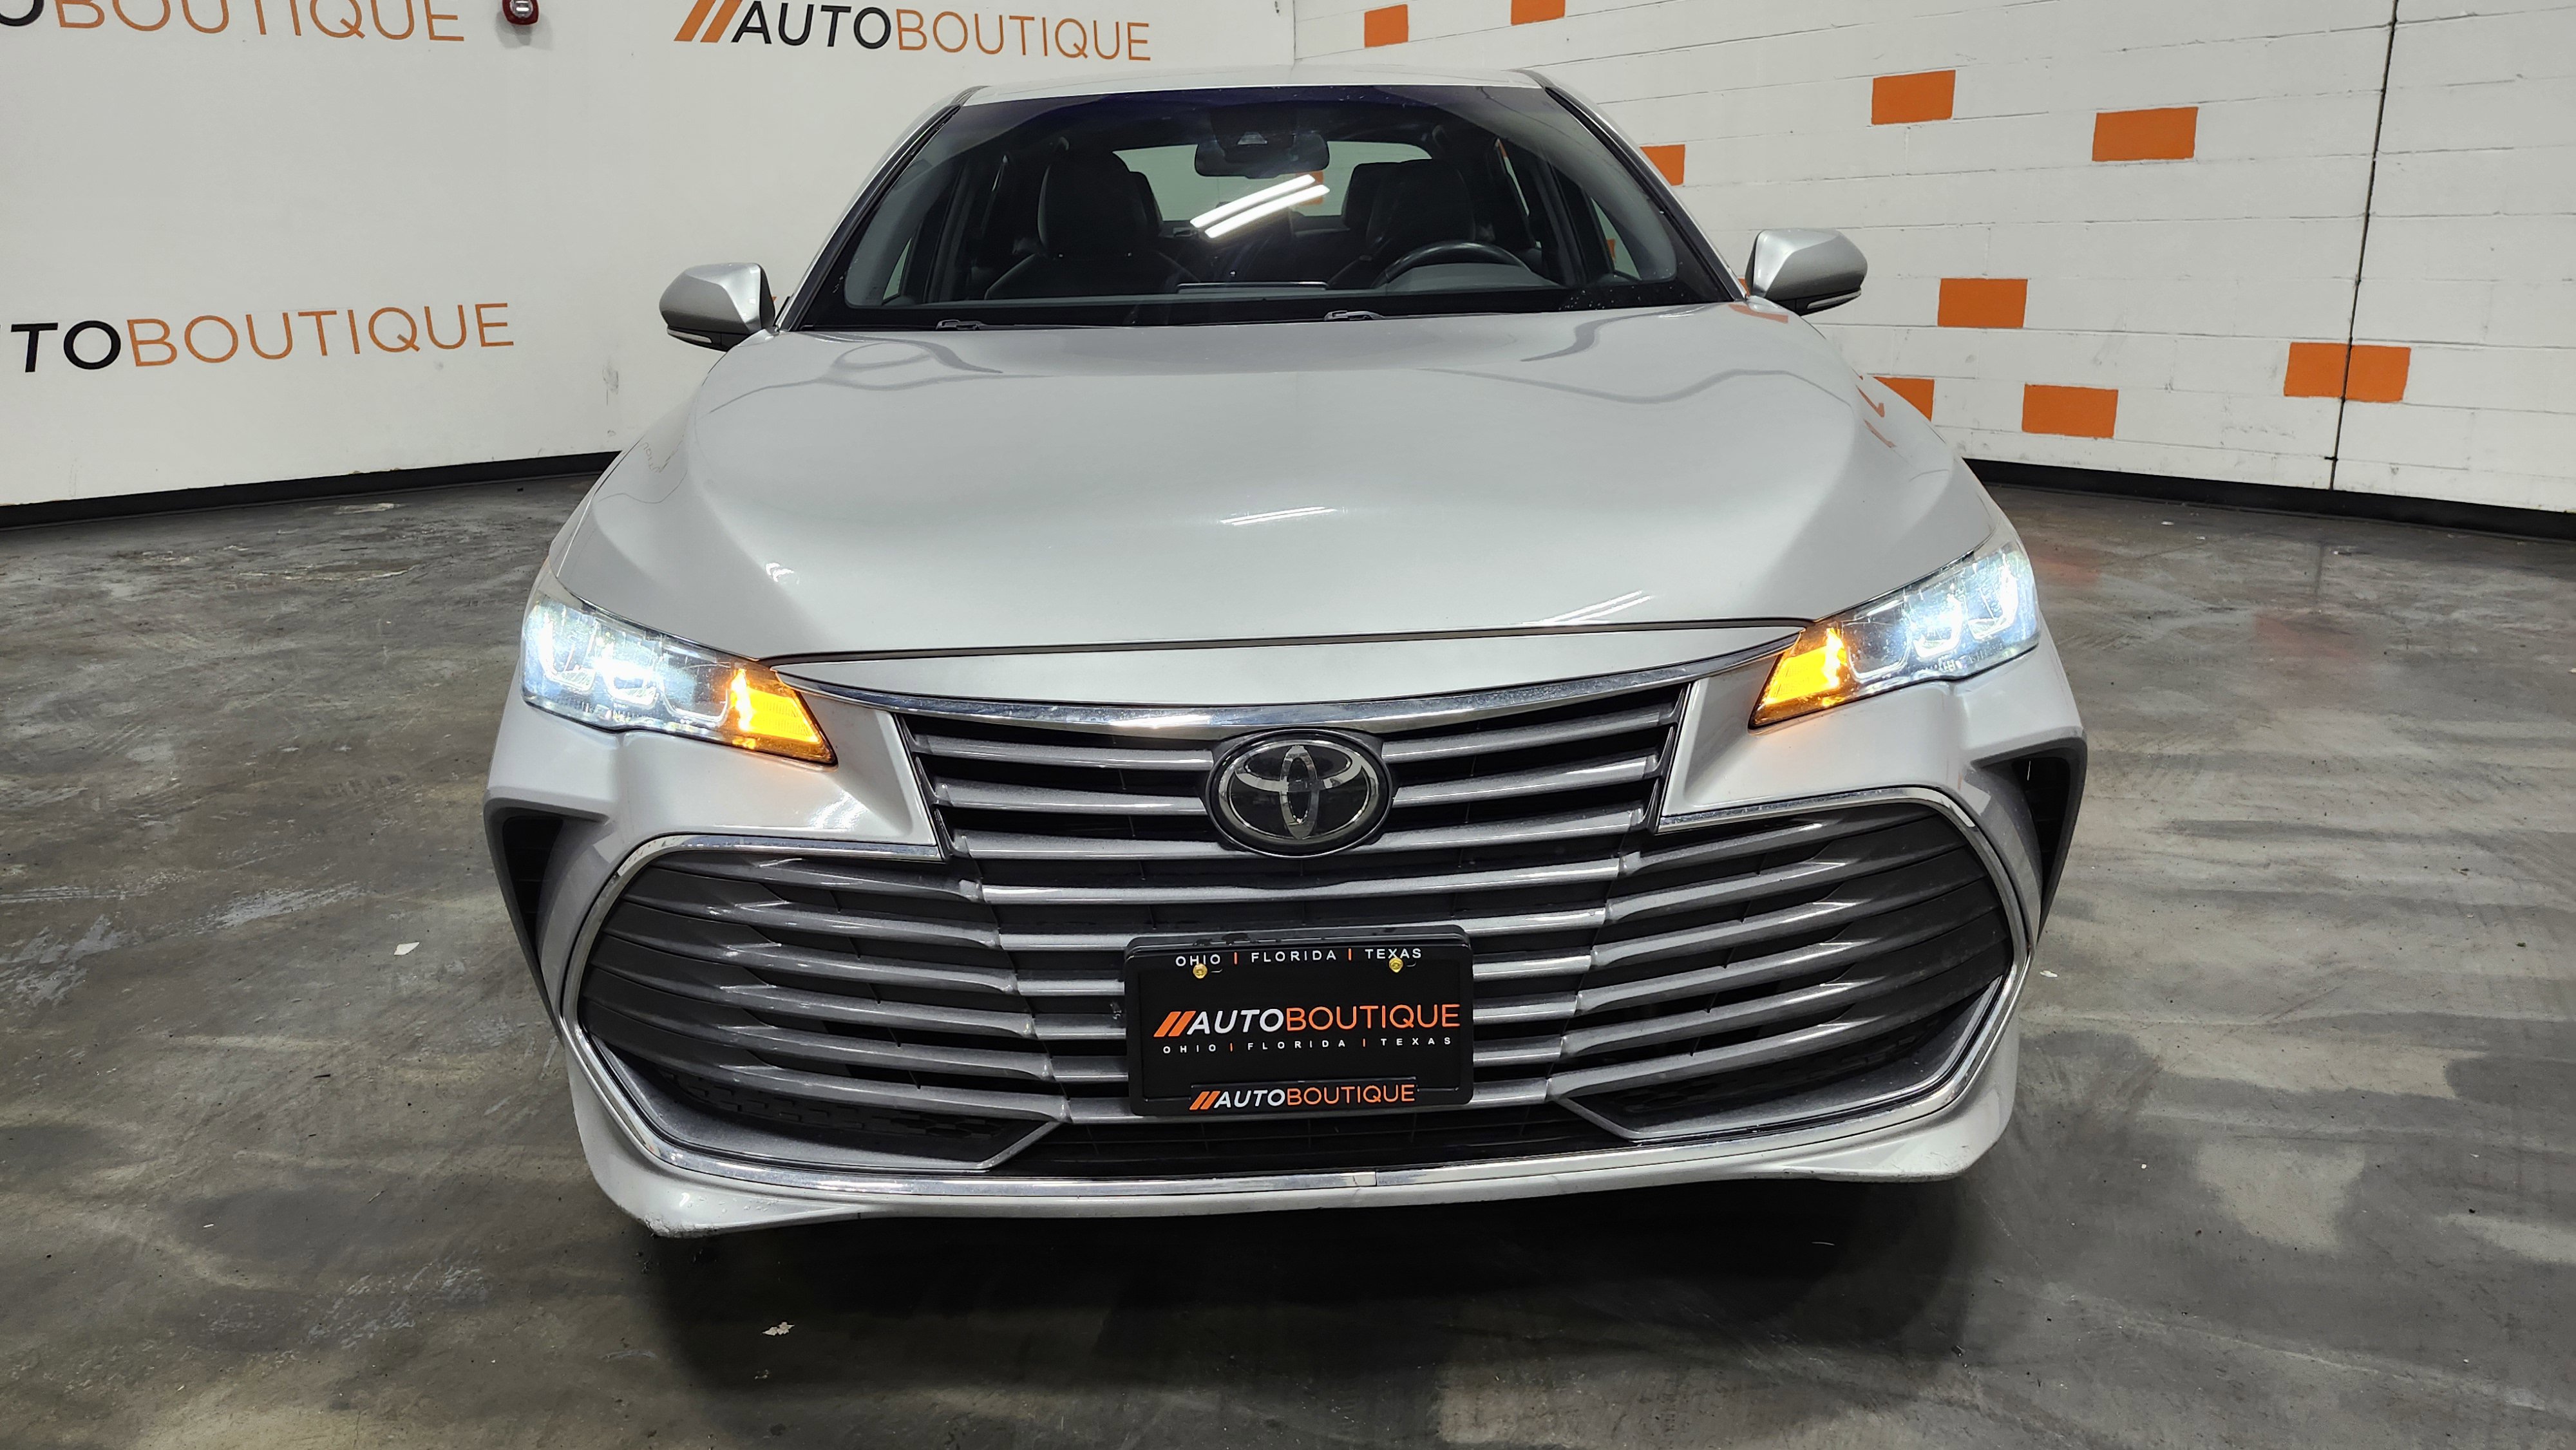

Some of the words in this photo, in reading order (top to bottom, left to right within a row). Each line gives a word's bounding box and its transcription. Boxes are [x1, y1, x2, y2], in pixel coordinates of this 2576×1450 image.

[1175, 954, 1220, 966] OHIO
[1251, 950, 1336, 963] FLORIDA
[1365, 948, 1421, 959] TEXAS
[1162, 1044, 1216, 1054] OHIO
[1247, 1039, 1345, 1051] FLORIDA
[1380, 1037, 1451, 1046] TEXAS
